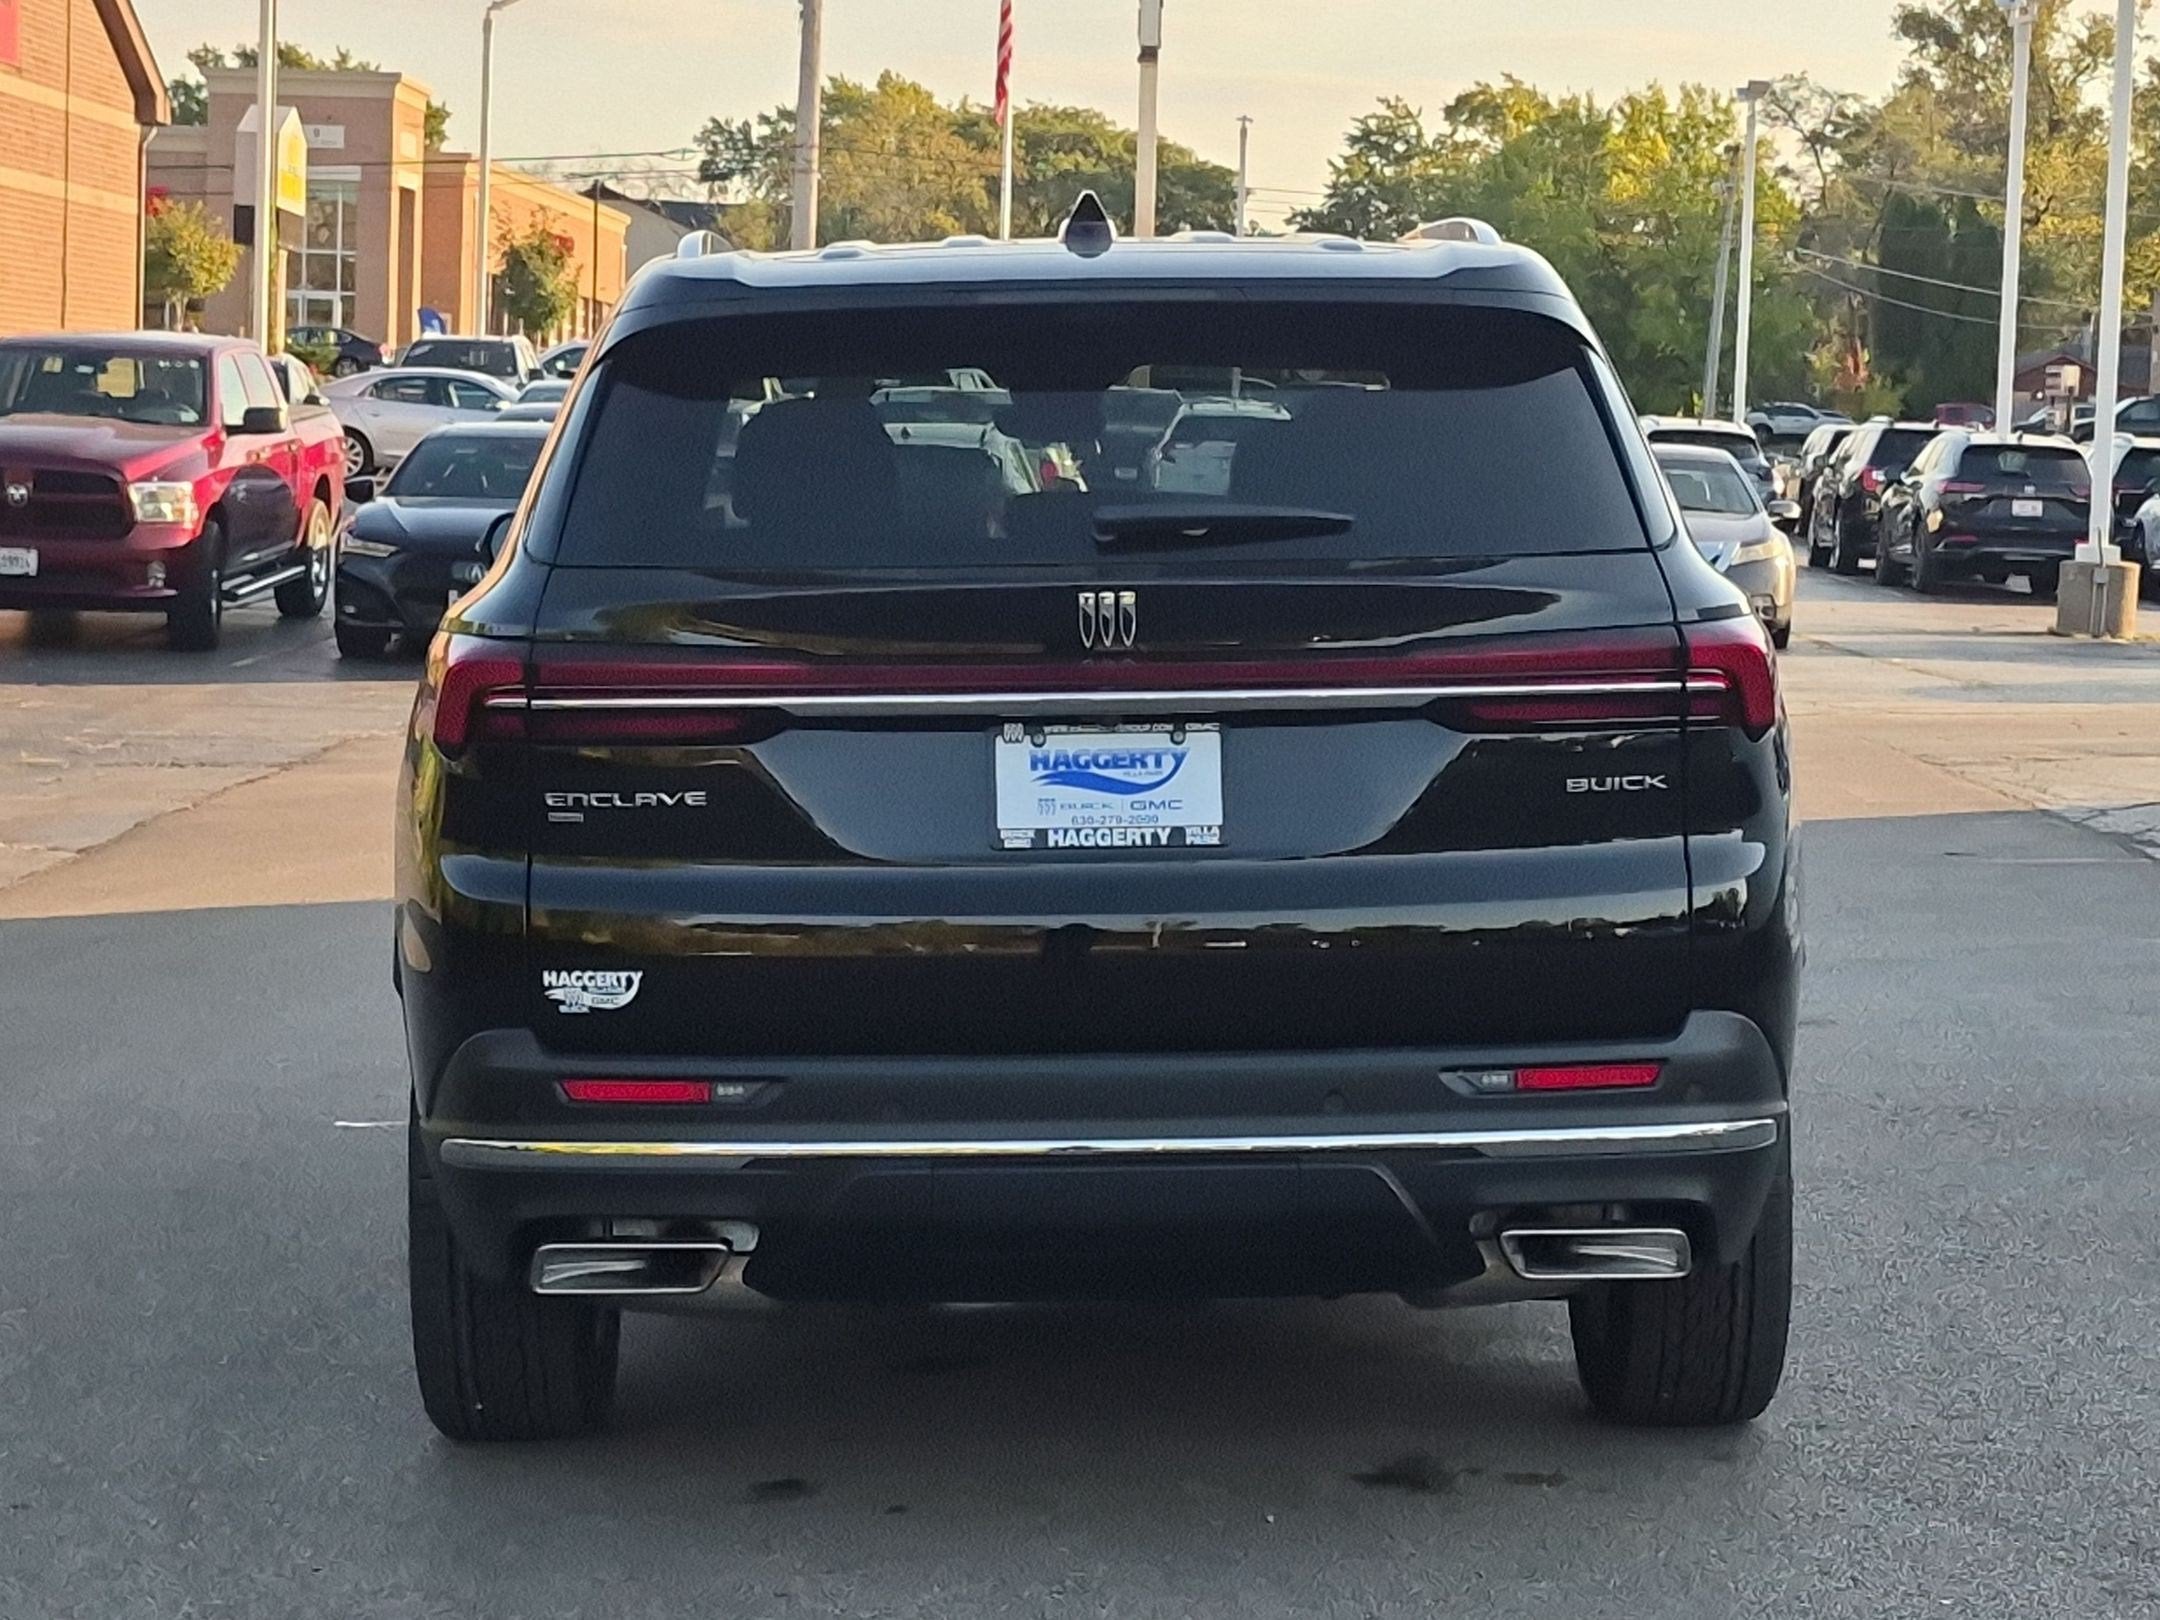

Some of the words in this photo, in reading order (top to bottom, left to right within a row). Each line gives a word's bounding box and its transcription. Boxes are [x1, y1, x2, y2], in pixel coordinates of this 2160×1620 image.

[1029, 748, 1190, 772] HAGGERTY
[1566, 775, 1669, 792] BUICK
[545, 791, 707, 807] ENCLAVE
[1130, 800, 1183, 811] GMC
[1048, 826, 1171, 847] HAGGERTY
[542, 970, 643, 987] HAGGERTY
